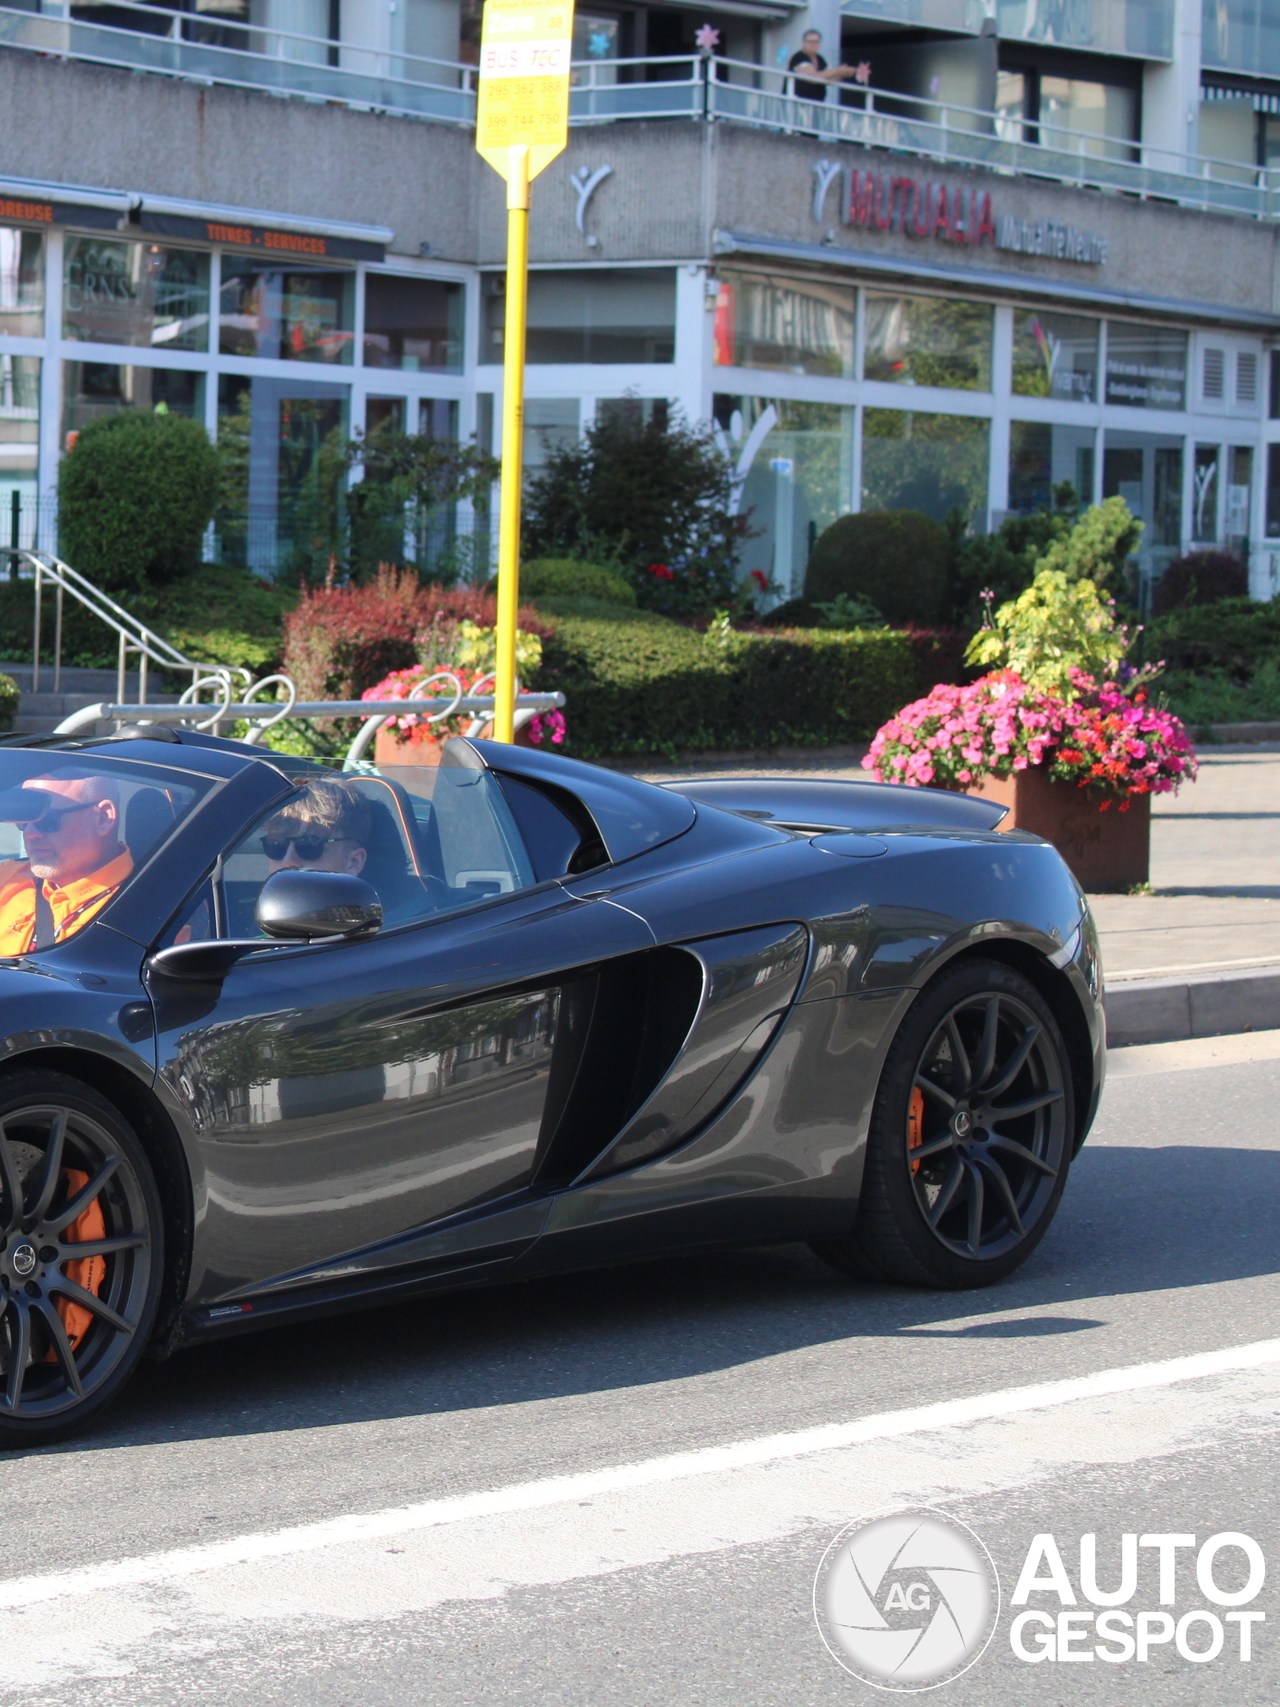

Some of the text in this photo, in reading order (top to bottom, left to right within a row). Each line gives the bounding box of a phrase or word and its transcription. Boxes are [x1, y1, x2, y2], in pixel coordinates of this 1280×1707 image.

[487, 13, 563, 34] Zone 38
[486, 48, 562, 69] BUS TEC
[488, 81, 562, 97] 295 362 388
[486, 112, 560, 128] 399 744 750
[846, 168, 995, 246] MUTUALIA
[207, 223, 252, 245] TITRES
[264, 231, 326, 254] SERVICES
